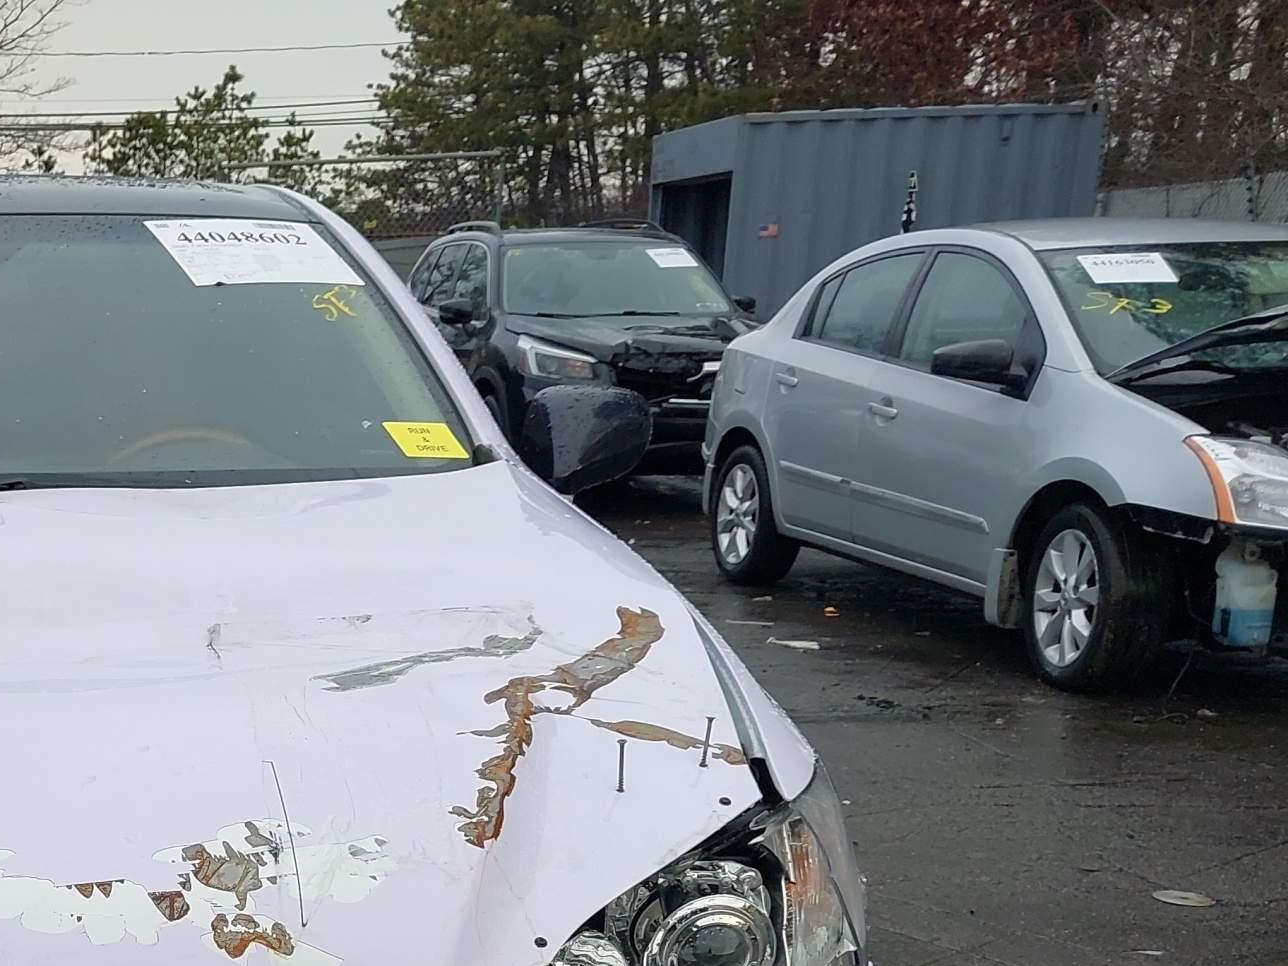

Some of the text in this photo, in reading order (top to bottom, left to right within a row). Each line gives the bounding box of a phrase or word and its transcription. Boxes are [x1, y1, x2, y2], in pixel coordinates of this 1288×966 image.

[177, 231, 308, 246] 44048602
[407, 427, 431, 435] RUN
[415, 444, 449, 452] DRIVE
